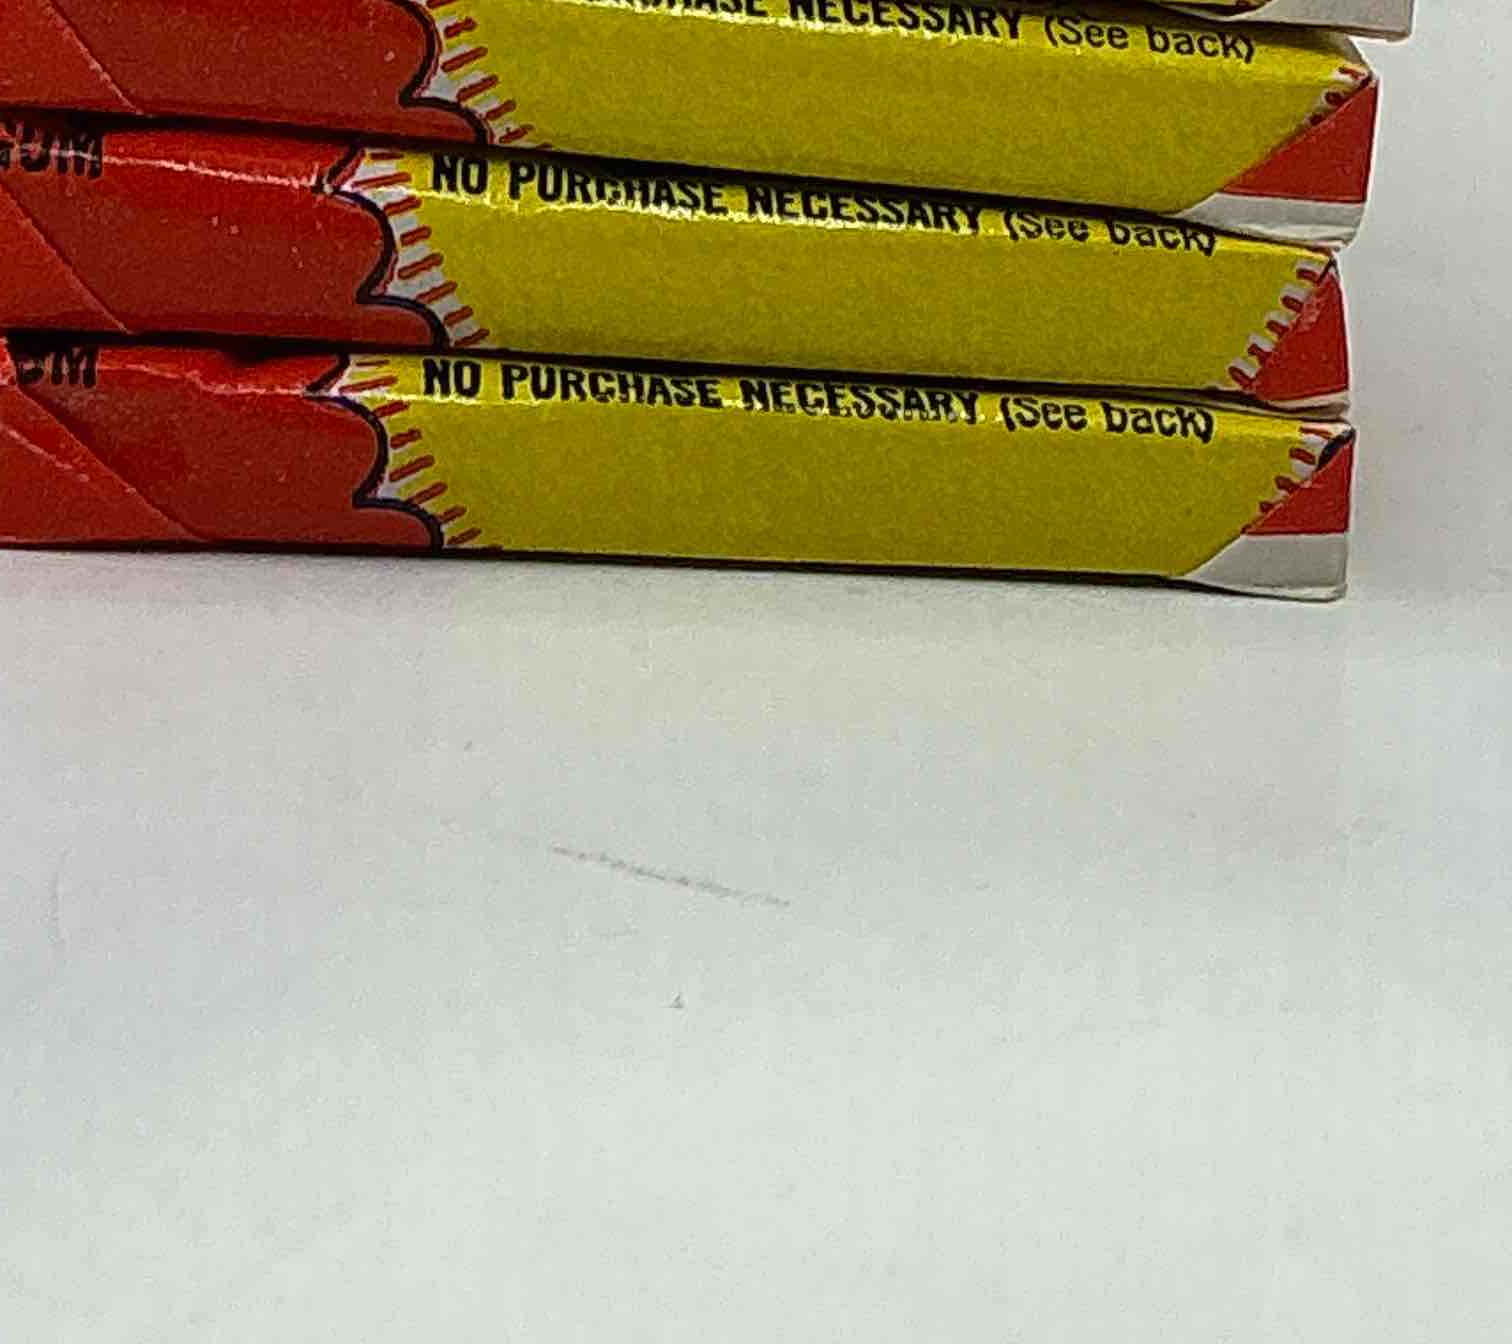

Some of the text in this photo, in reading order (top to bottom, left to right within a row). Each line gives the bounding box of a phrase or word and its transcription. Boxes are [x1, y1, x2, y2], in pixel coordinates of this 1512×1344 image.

[1044, 15, 1129, 50] (See
[1146, 23, 1255, 64] back)
[431, 153, 488, 195] NO
[744, 184, 983, 234] NECESSARY
[422, 357, 482, 401] NO
[500, 362, 724, 410] PURCHASE
[738, 378, 979, 426] NECESSARY
[999, 395, 1088, 434] (See
